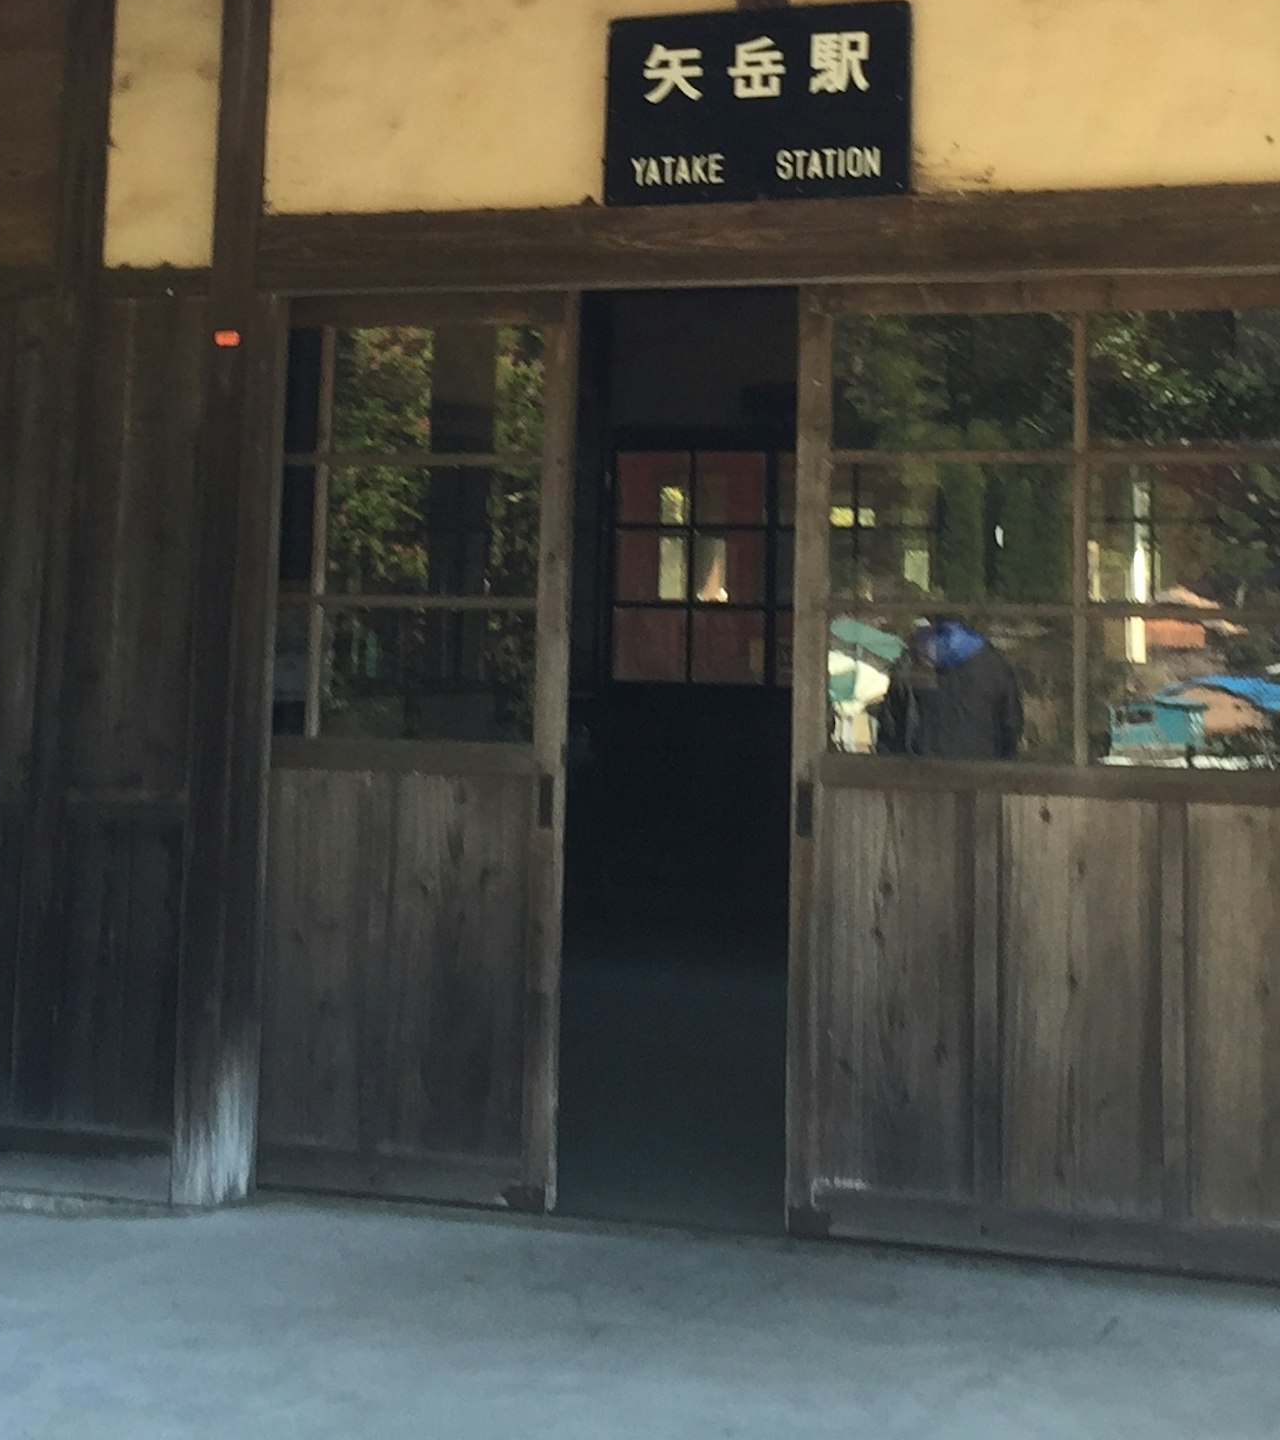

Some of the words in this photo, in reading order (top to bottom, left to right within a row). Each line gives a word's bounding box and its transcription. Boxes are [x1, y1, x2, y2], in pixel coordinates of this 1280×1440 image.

[643, 31, 870, 104] 矢岳駅
[631, 152, 725, 187] YATAKE
[775, 146, 881, 180] STATION
